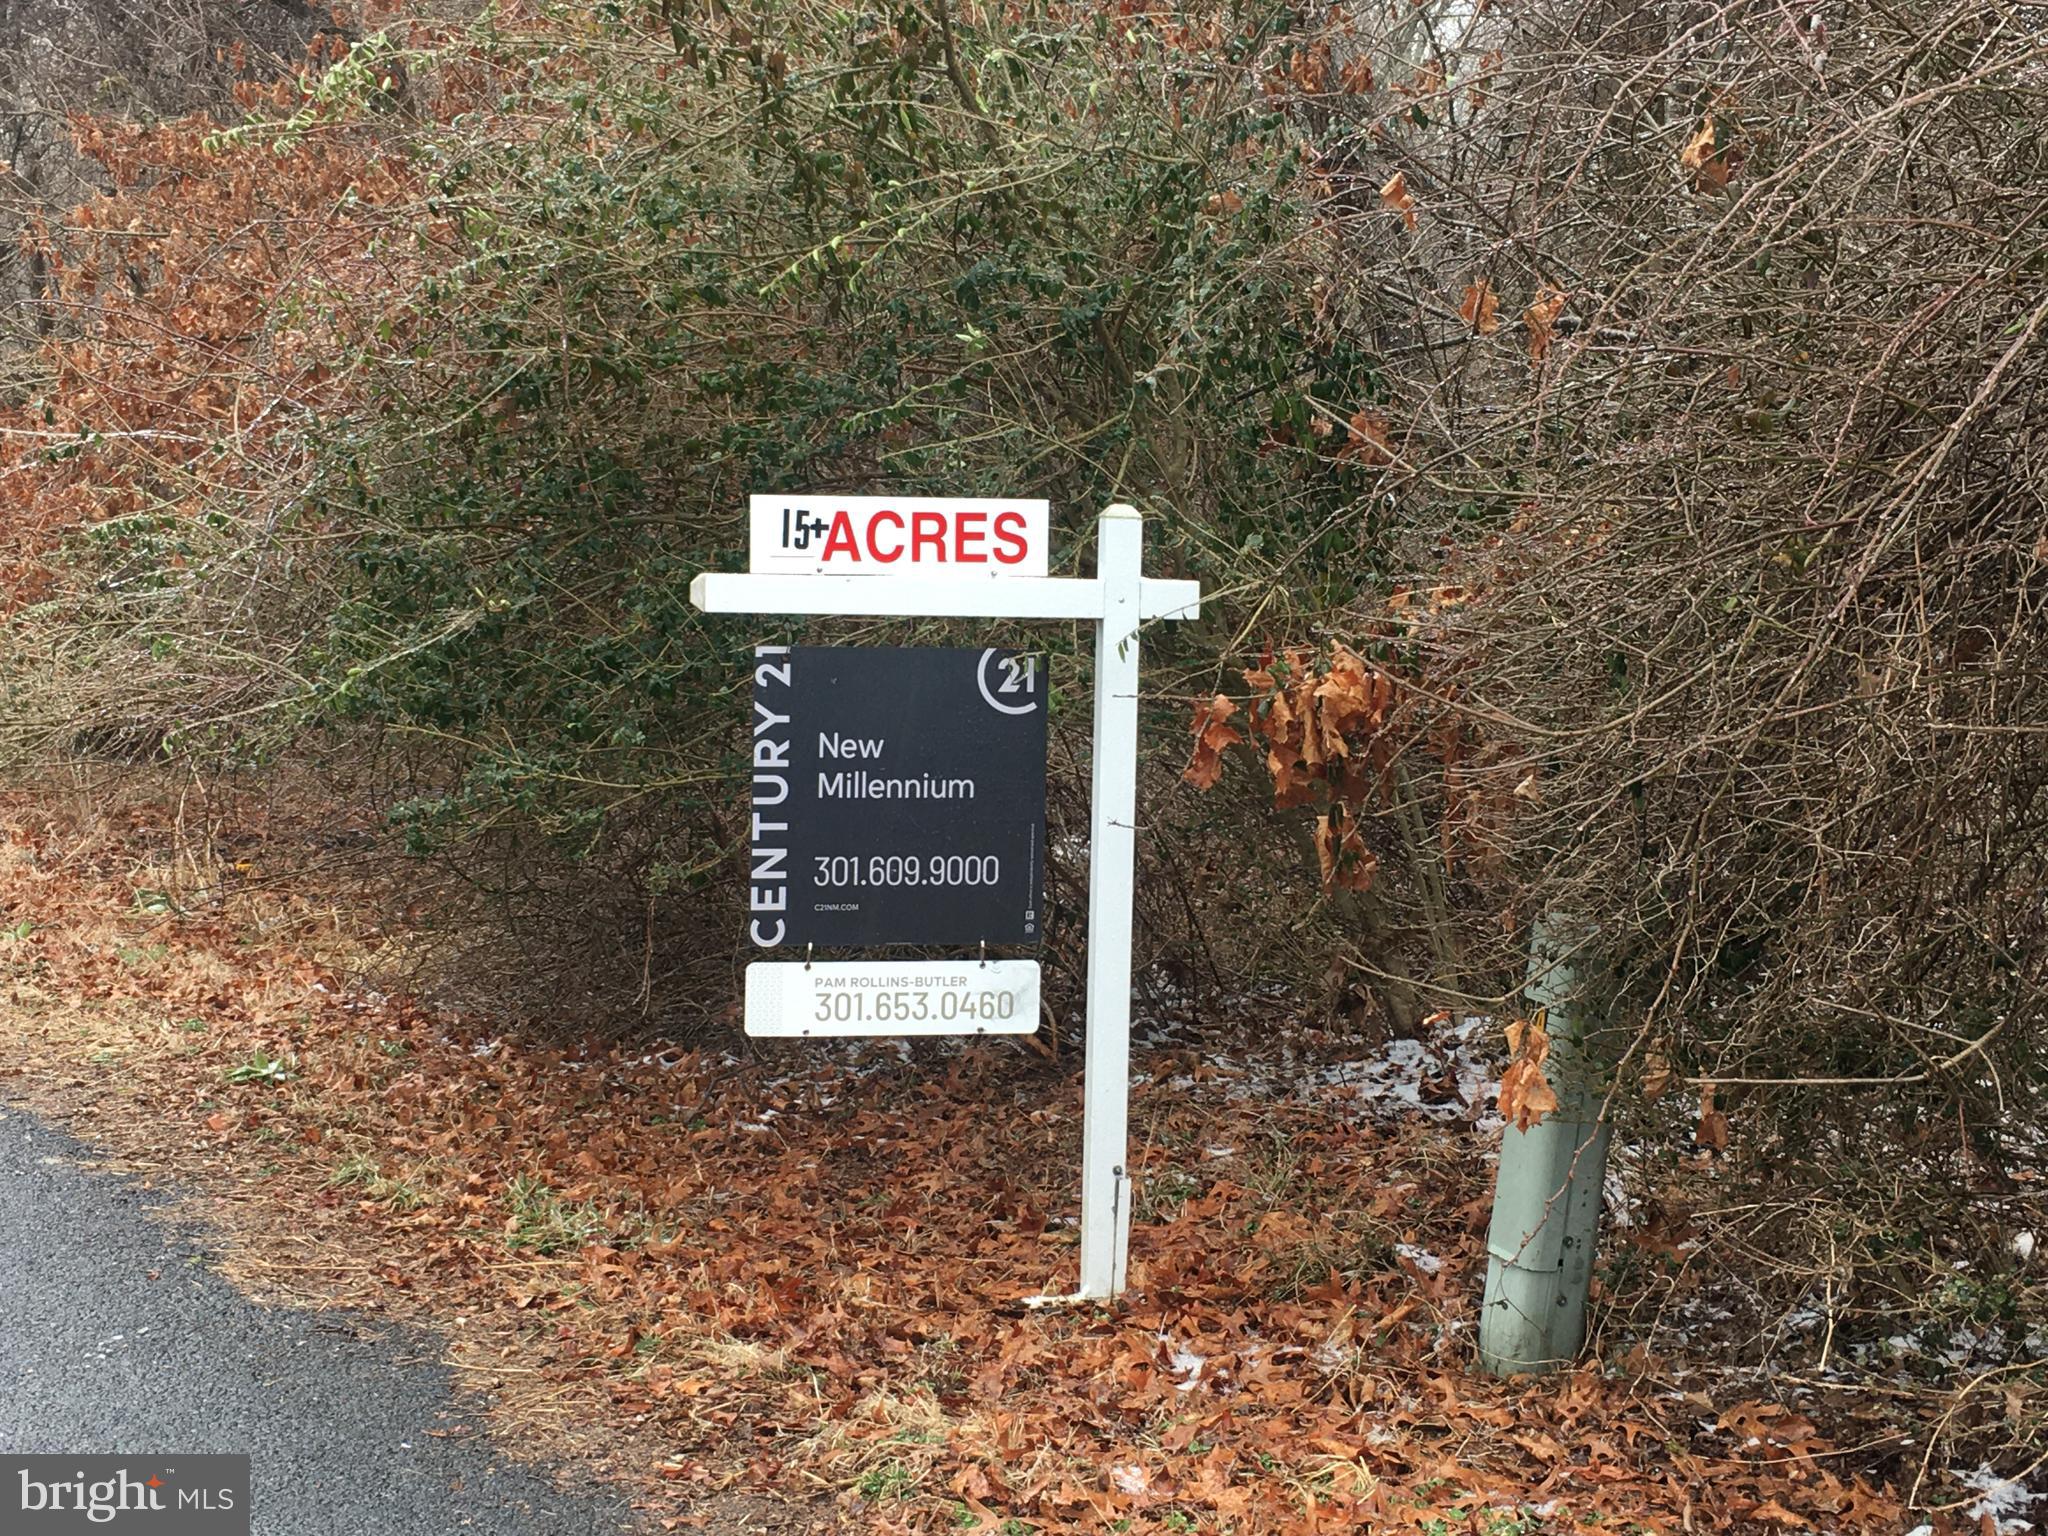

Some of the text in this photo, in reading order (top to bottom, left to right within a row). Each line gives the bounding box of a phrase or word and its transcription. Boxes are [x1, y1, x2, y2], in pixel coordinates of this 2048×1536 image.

[782, 508, 1028, 564] 15+ ACRES
[818, 732, 884, 759] New
[750, 645, 791, 948] CENTURY 21
[817, 771, 975, 799] Millennium
[813, 855, 1000, 887] 301.609.9000
[814, 903, 860, 912] C21NM.COM
[814, 976, 967, 988] PAM ROLLINS-BUTLER
[814, 990, 1015, 1022] 301.653.0460
